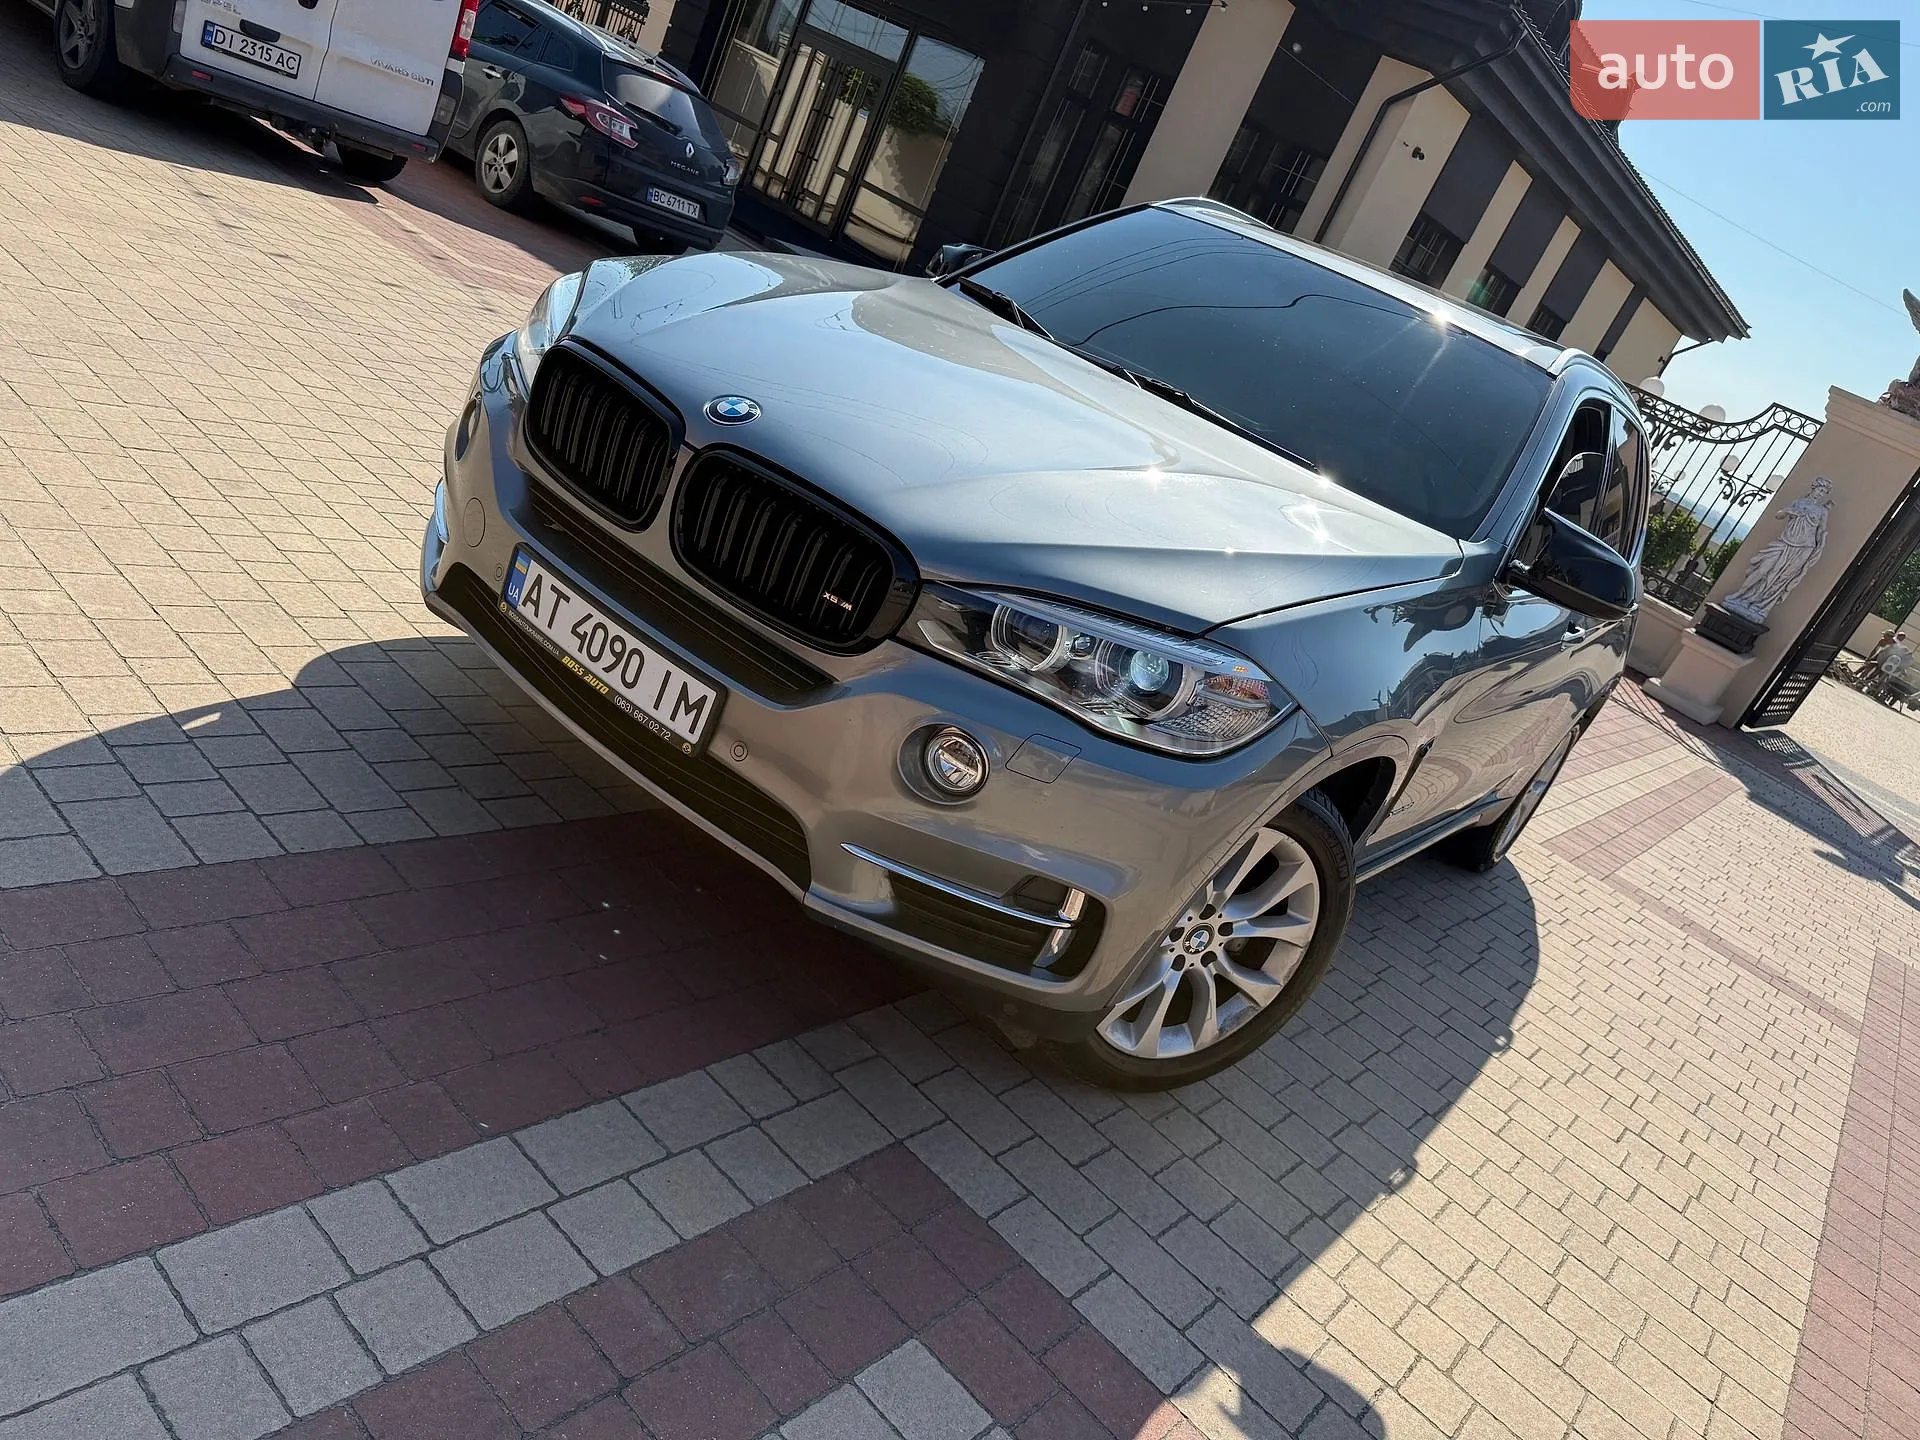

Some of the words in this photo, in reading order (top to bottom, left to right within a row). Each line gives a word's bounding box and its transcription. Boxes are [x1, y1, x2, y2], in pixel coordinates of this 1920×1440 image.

[213, 29, 234, 49] DI
[239, 38, 273, 62] 2315
[275, 52, 297, 71] AC
[653, 190, 666, 204] BC
[666, 195, 685, 212] 6711
[686, 202, 698, 217] TX
[507, 582, 520, 601] UA
[521, 572, 571, 631] AT
[570, 612, 645, 690] 4090
[652, 669, 709, 735] IM
[561, 655, 585, 677] BOSS
[583, 673, 610, 696] AUTO
[614, 694, 633, 714] (063)
[633, 709, 649, 724] 667
[648, 720, 660, 733] 02
[660, 727, 671, 741] 72
